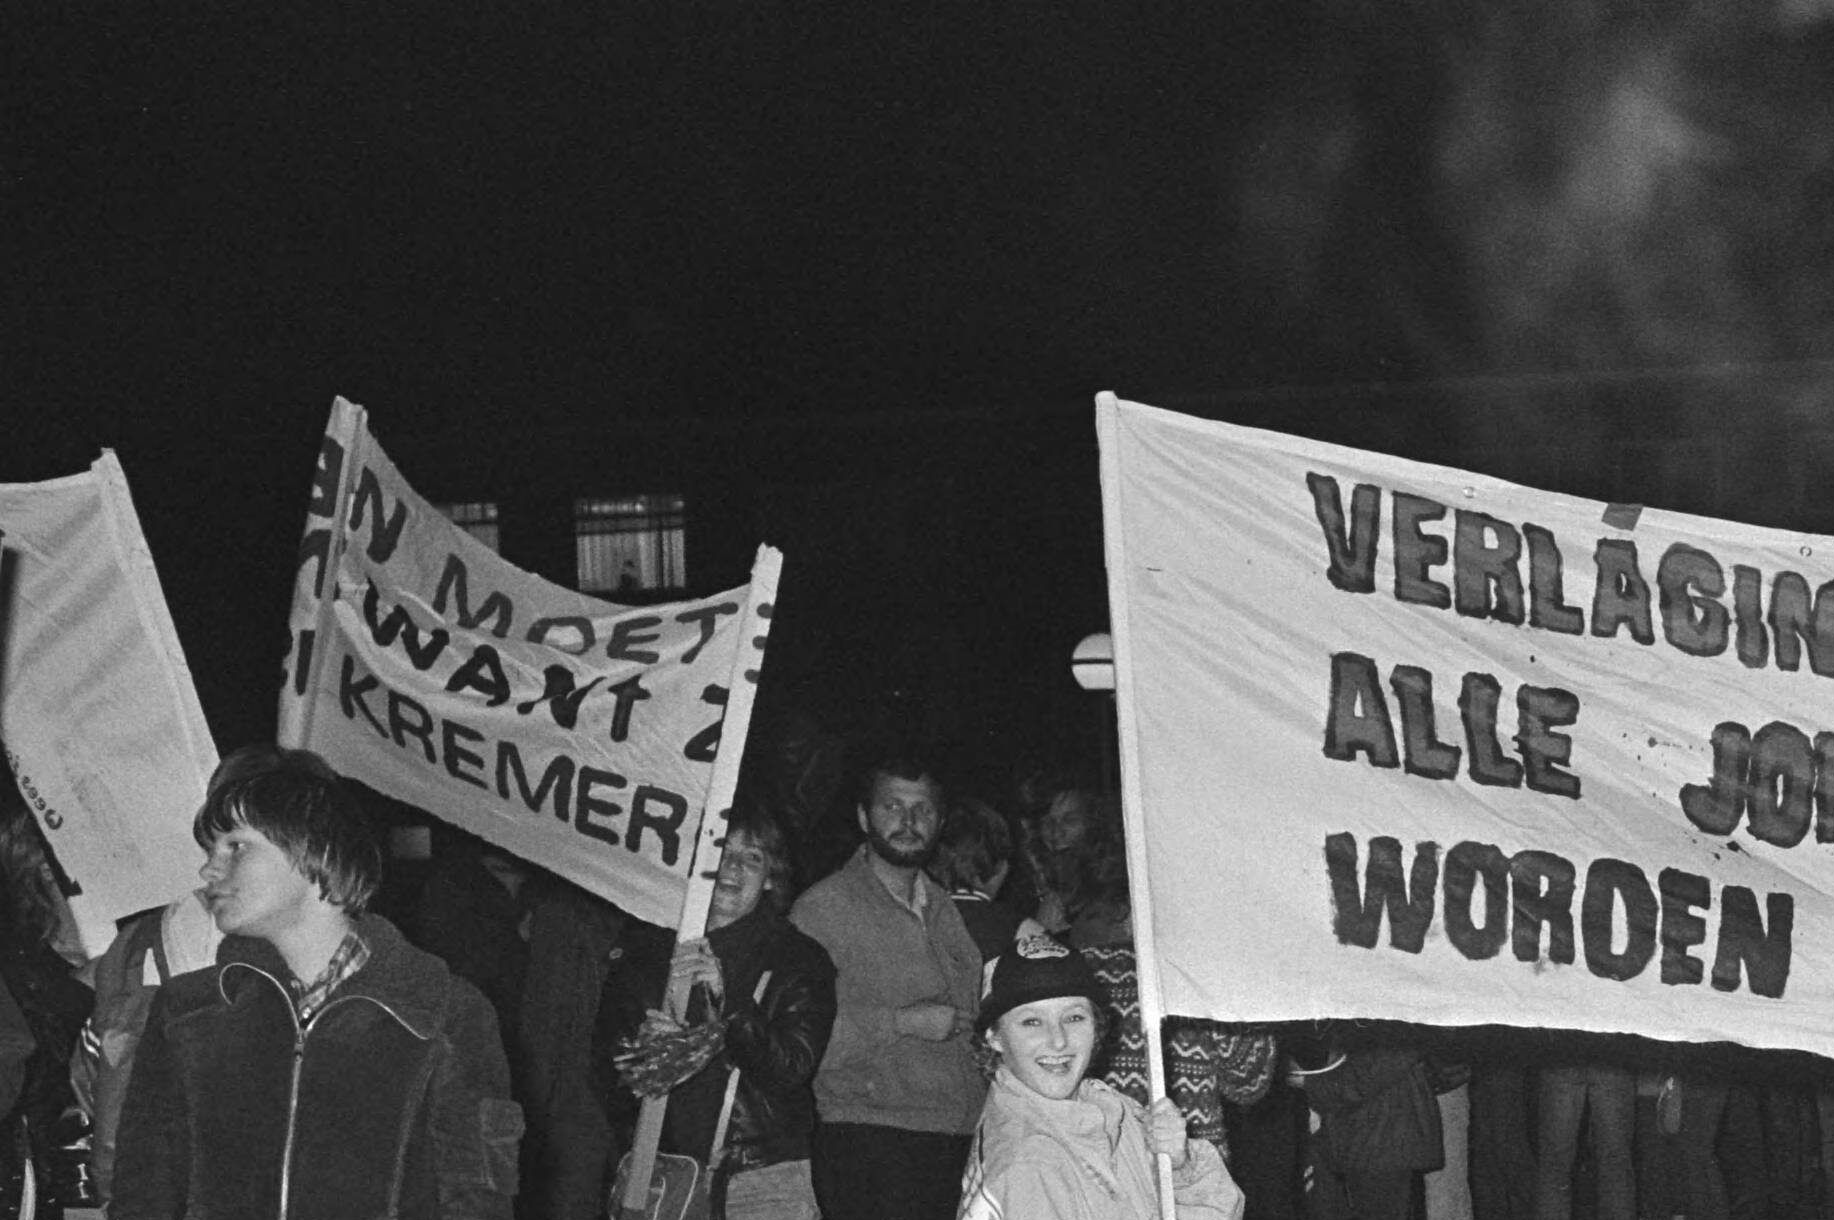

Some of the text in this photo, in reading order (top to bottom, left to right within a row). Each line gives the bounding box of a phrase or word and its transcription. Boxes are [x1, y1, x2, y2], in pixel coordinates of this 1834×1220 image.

[432, 552, 739, 665] MOET
[340, 654, 689, 867] KREMER
[1322, 650, 1582, 800] ALLE
[1323, 830, 1795, 999] WORDEN
